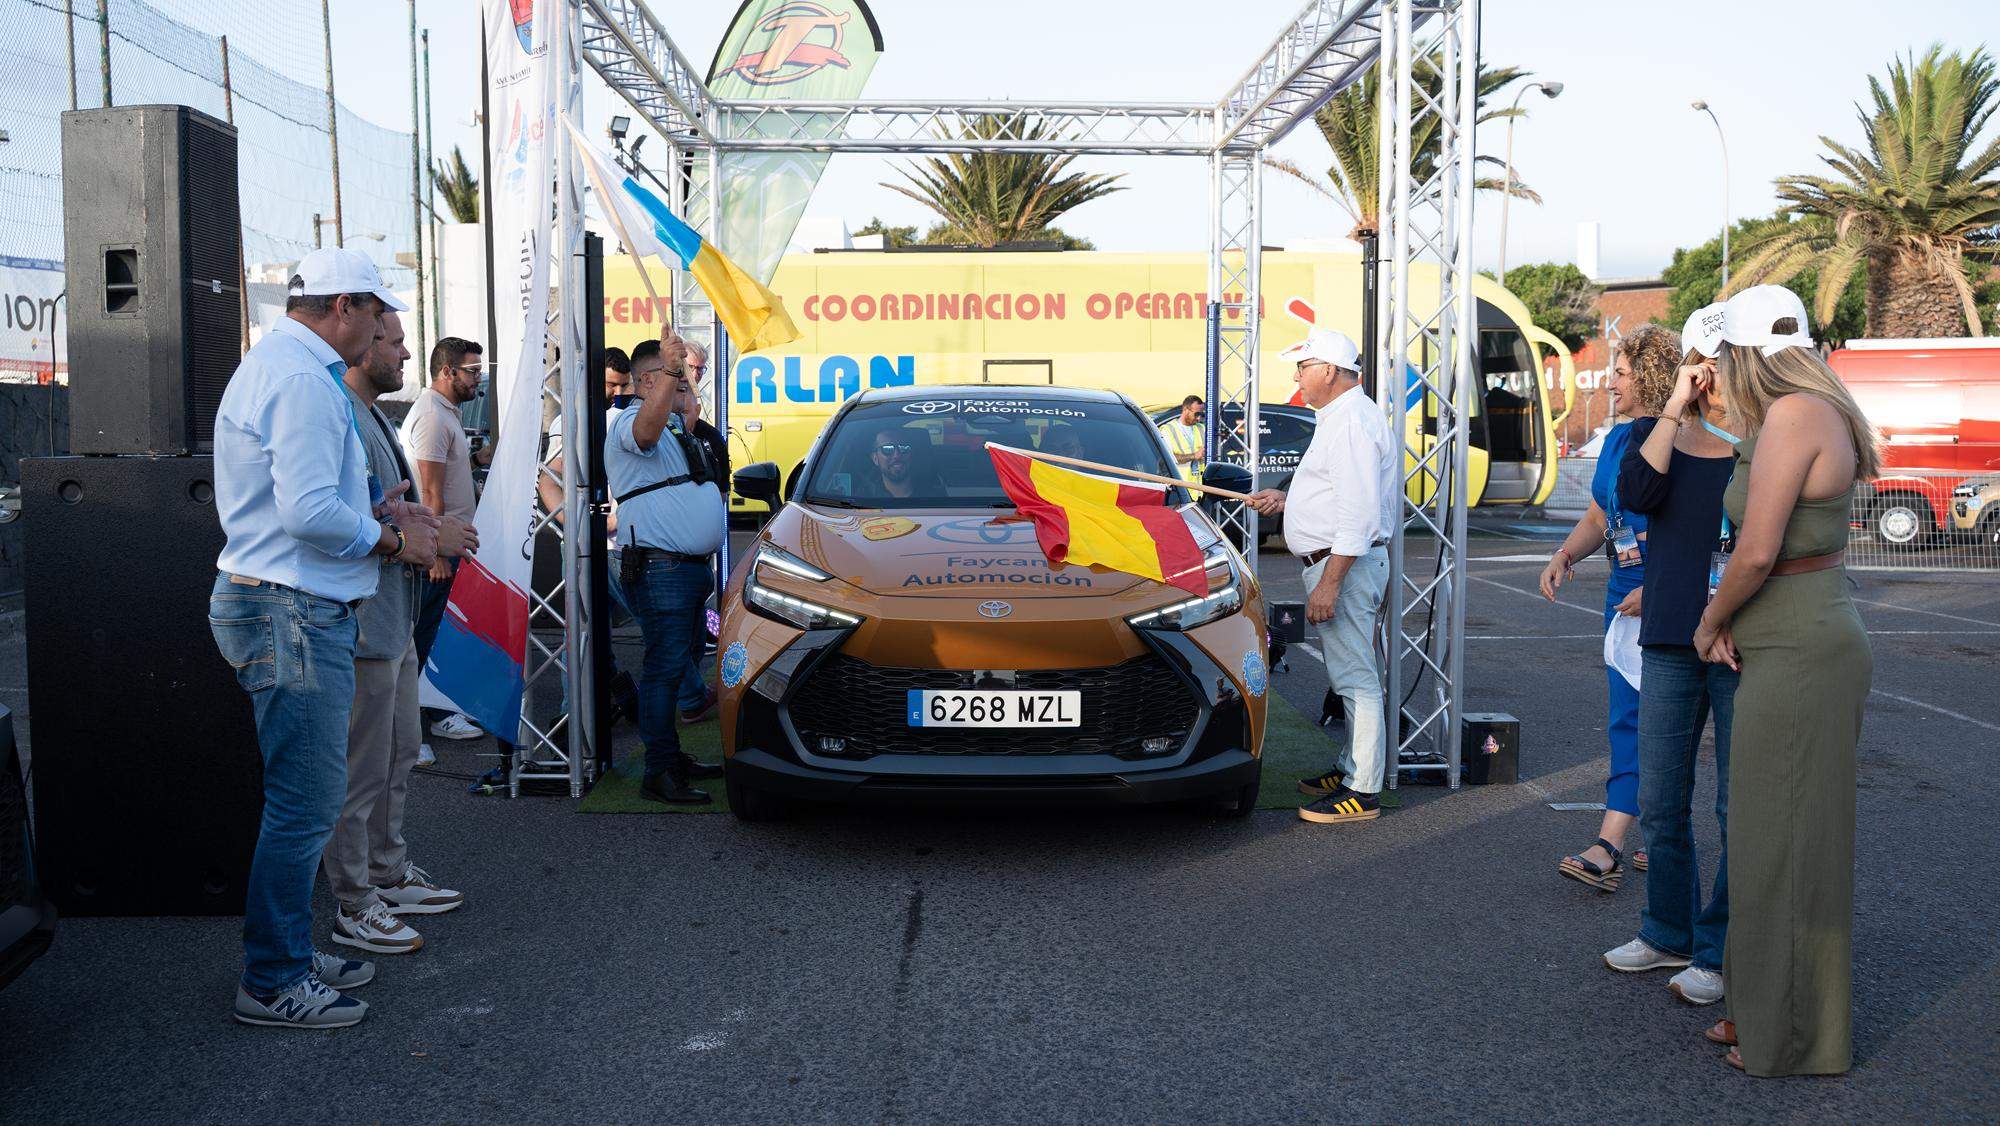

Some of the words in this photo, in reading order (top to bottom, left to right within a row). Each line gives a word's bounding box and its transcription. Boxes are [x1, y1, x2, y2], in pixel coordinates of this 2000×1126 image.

[803, 293, 1066, 321] COORDINACION
[1085, 292, 1265, 320] OPERATV
[964, 405, 1086, 418] Automoción
[947, 556, 1048, 569] Faycan
[902, 572, 1093, 587] Automoción
[912, 711, 920, 720] E
[930, 695, 1006, 723] 6268
[1018, 695, 1073, 723] MZL
